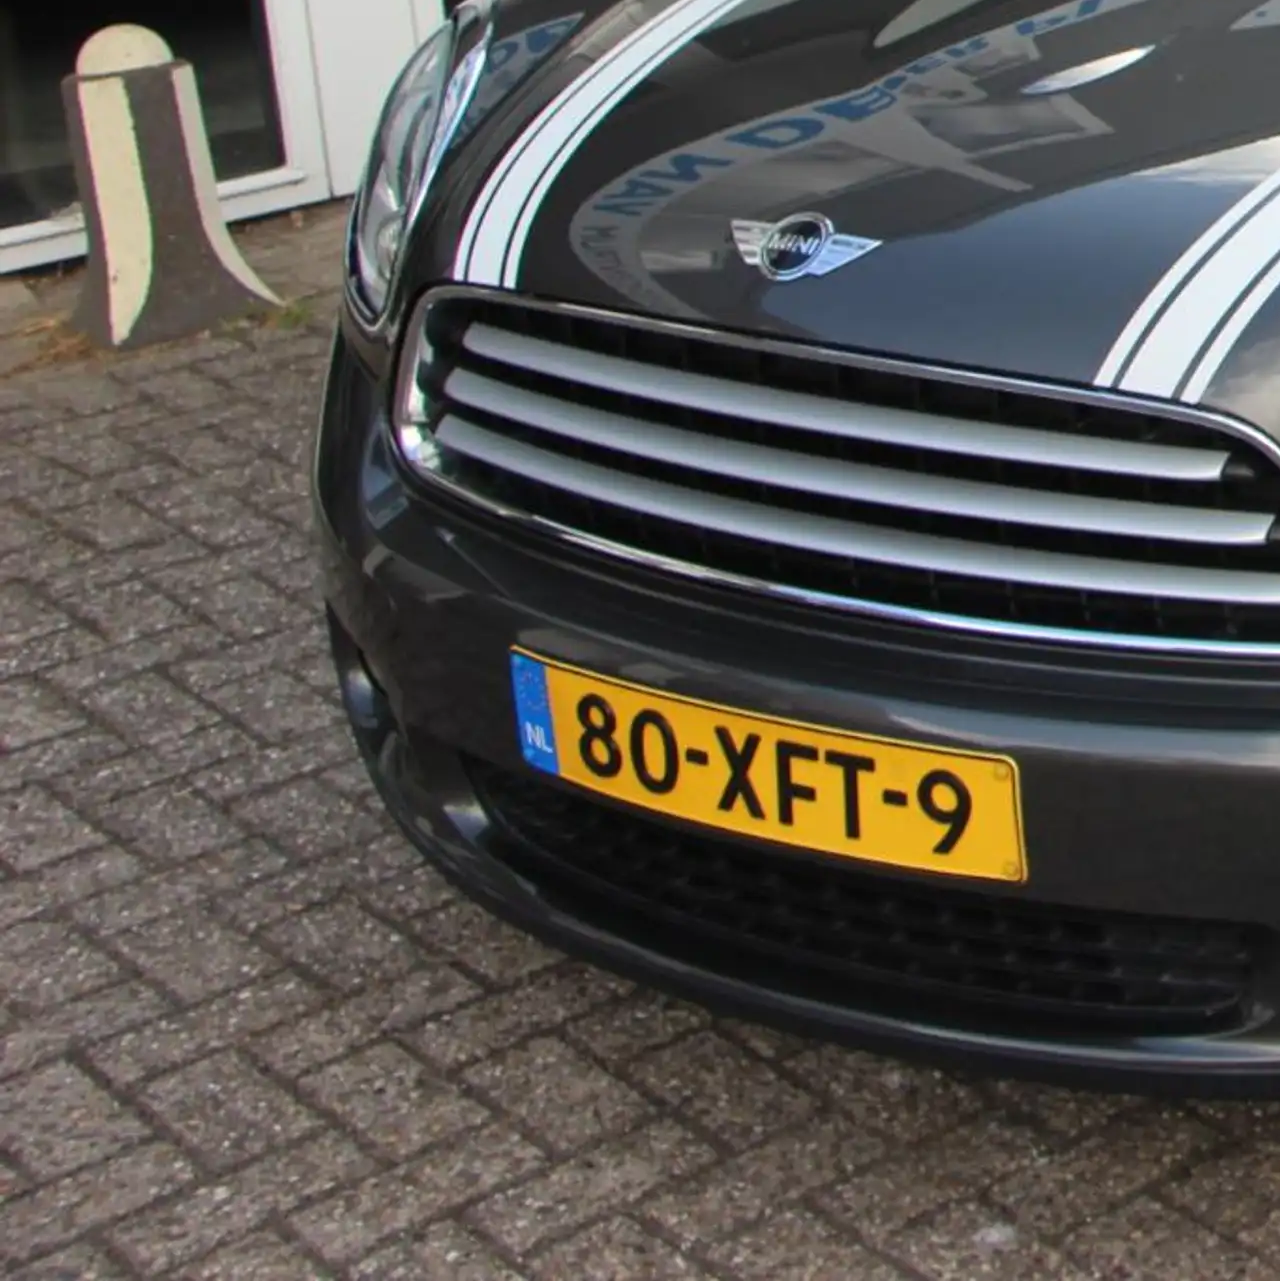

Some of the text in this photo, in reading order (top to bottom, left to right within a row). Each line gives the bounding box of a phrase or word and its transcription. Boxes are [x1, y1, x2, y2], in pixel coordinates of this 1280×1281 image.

[768, 233, 821, 255] MINI
[524, 692, 973, 856] NL 80-XFT-9
